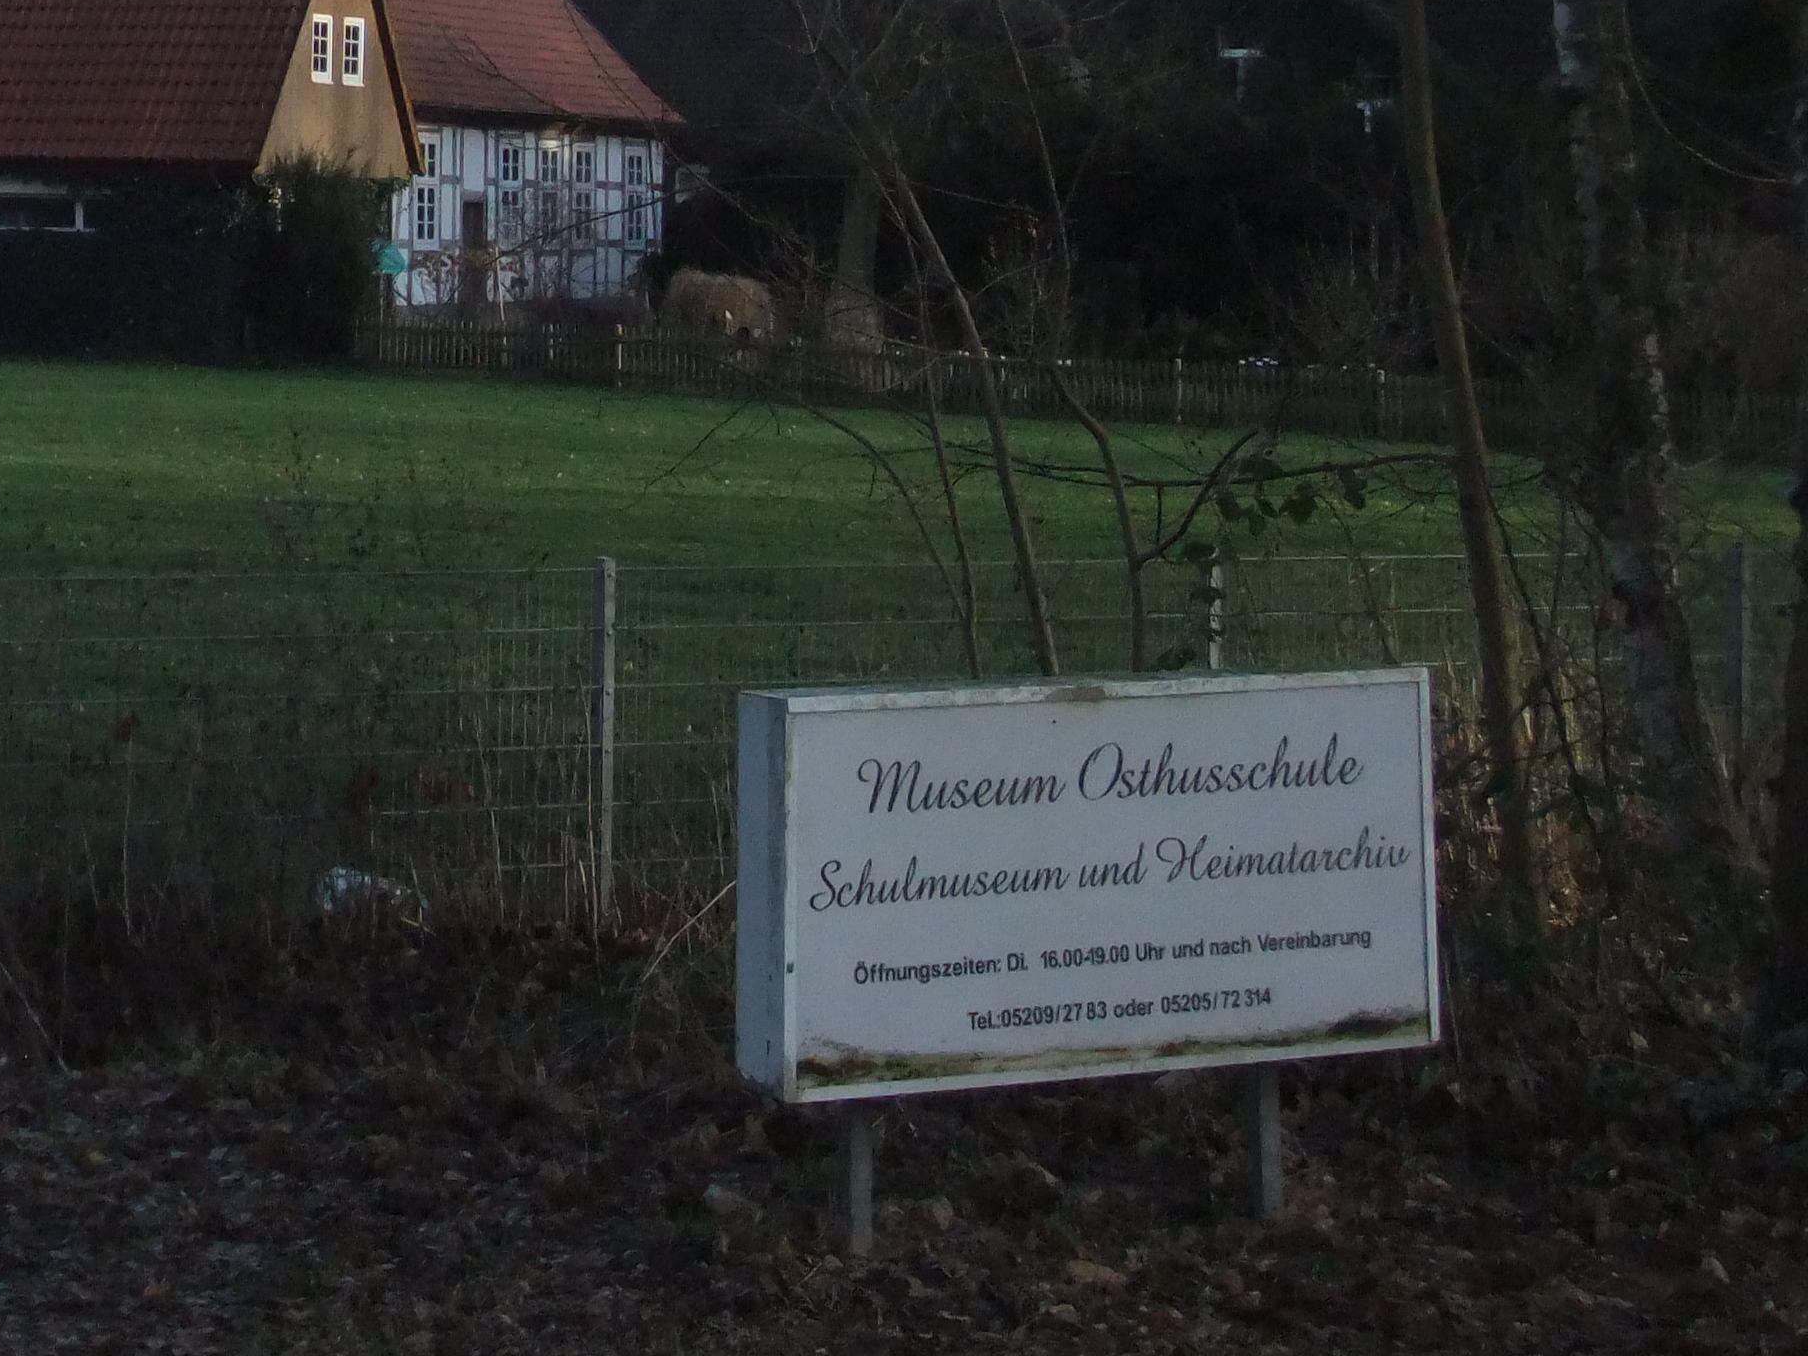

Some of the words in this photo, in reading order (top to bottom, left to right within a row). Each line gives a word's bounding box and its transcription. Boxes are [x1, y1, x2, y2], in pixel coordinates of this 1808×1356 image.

[857, 758, 1067, 814] Museum
[1078, 732, 1364, 801] Osthusschule
[809, 855, 1070, 912] Schulmuseum
[1078, 842, 1148, 888] und
[1155, 825, 1411, 883] Heimatarchiv
[854, 958, 1002, 985] Öffnungszeiten:
[1007, 952, 1028, 972] Di.
[1040, 944, 1130, 970] 16.00-19.00
[1135, 942, 1166, 962] Uhr
[1172, 939, 1204, 959] und
[1209, 935, 1252, 956] nach
[1257, 930, 1372, 952] Vereinbarung
[1113, 998, 1154, 1019] oder
[1244, 987, 1272, 1008] 314
